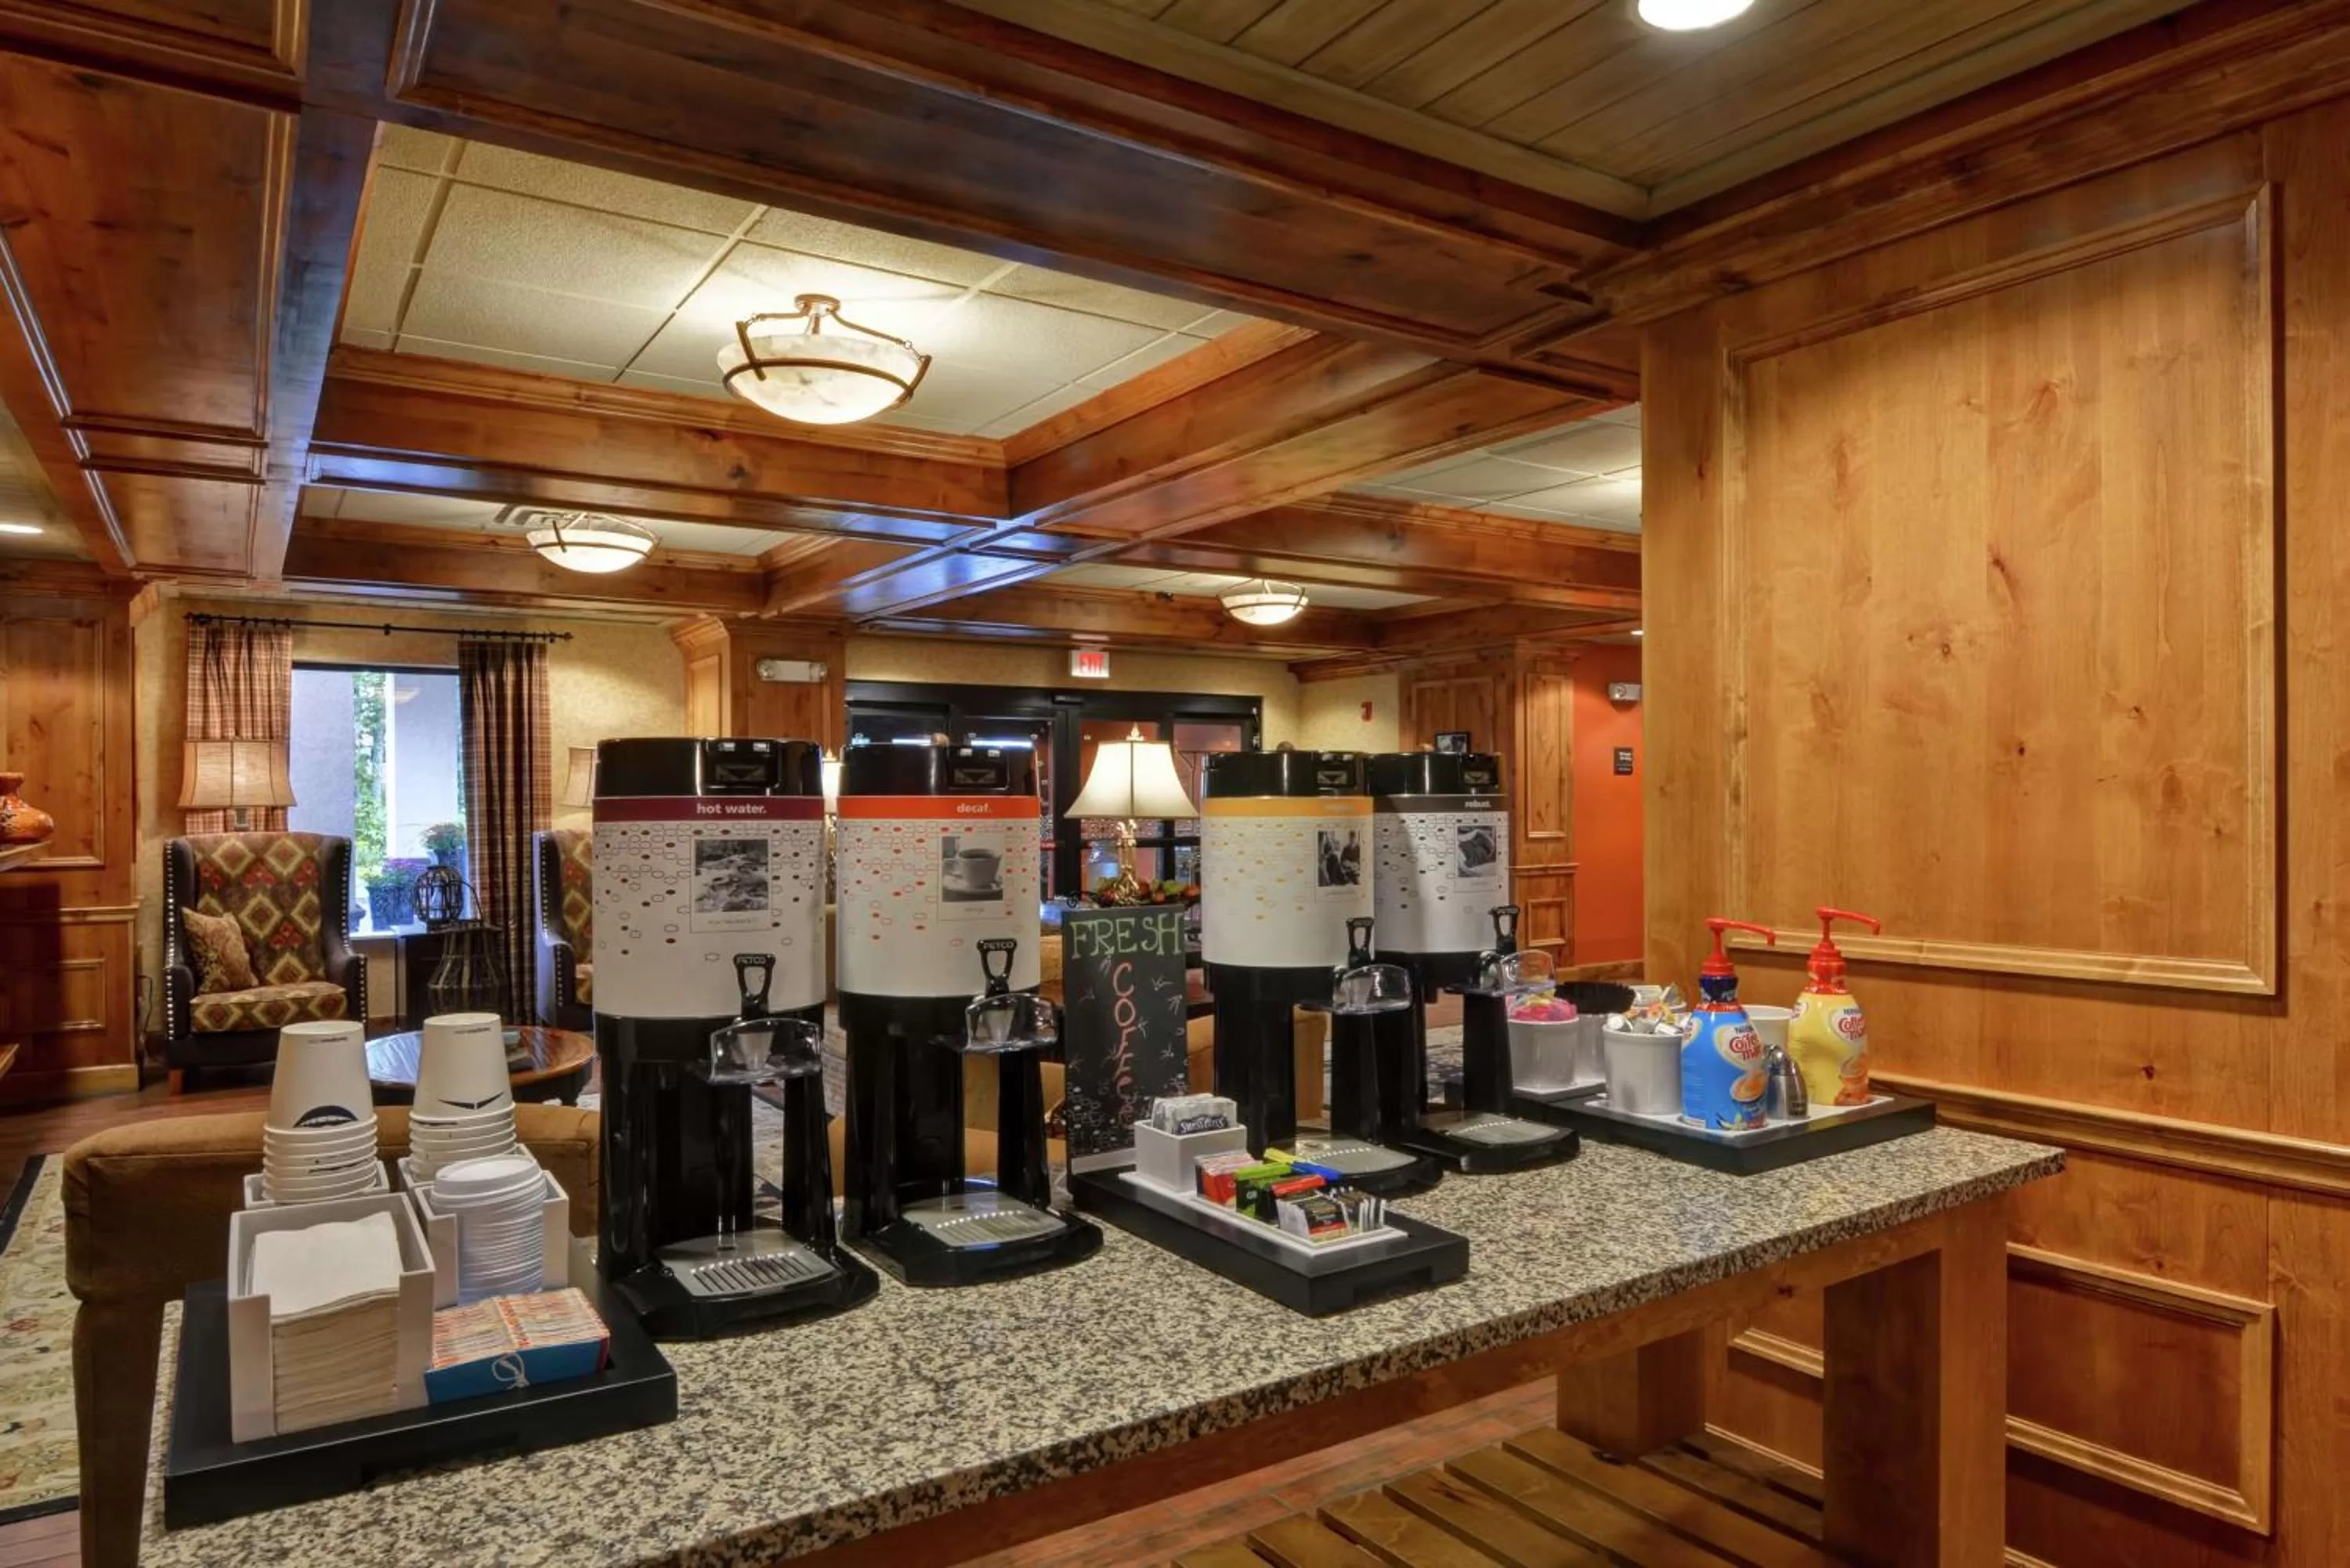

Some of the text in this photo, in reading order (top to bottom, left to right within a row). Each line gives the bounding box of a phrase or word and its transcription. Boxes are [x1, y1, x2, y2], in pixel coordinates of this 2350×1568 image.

[696, 804, 768, 814] hot water.
[956, 803, 993, 814] decaf.
[1071, 913, 1184, 959] FRESH
